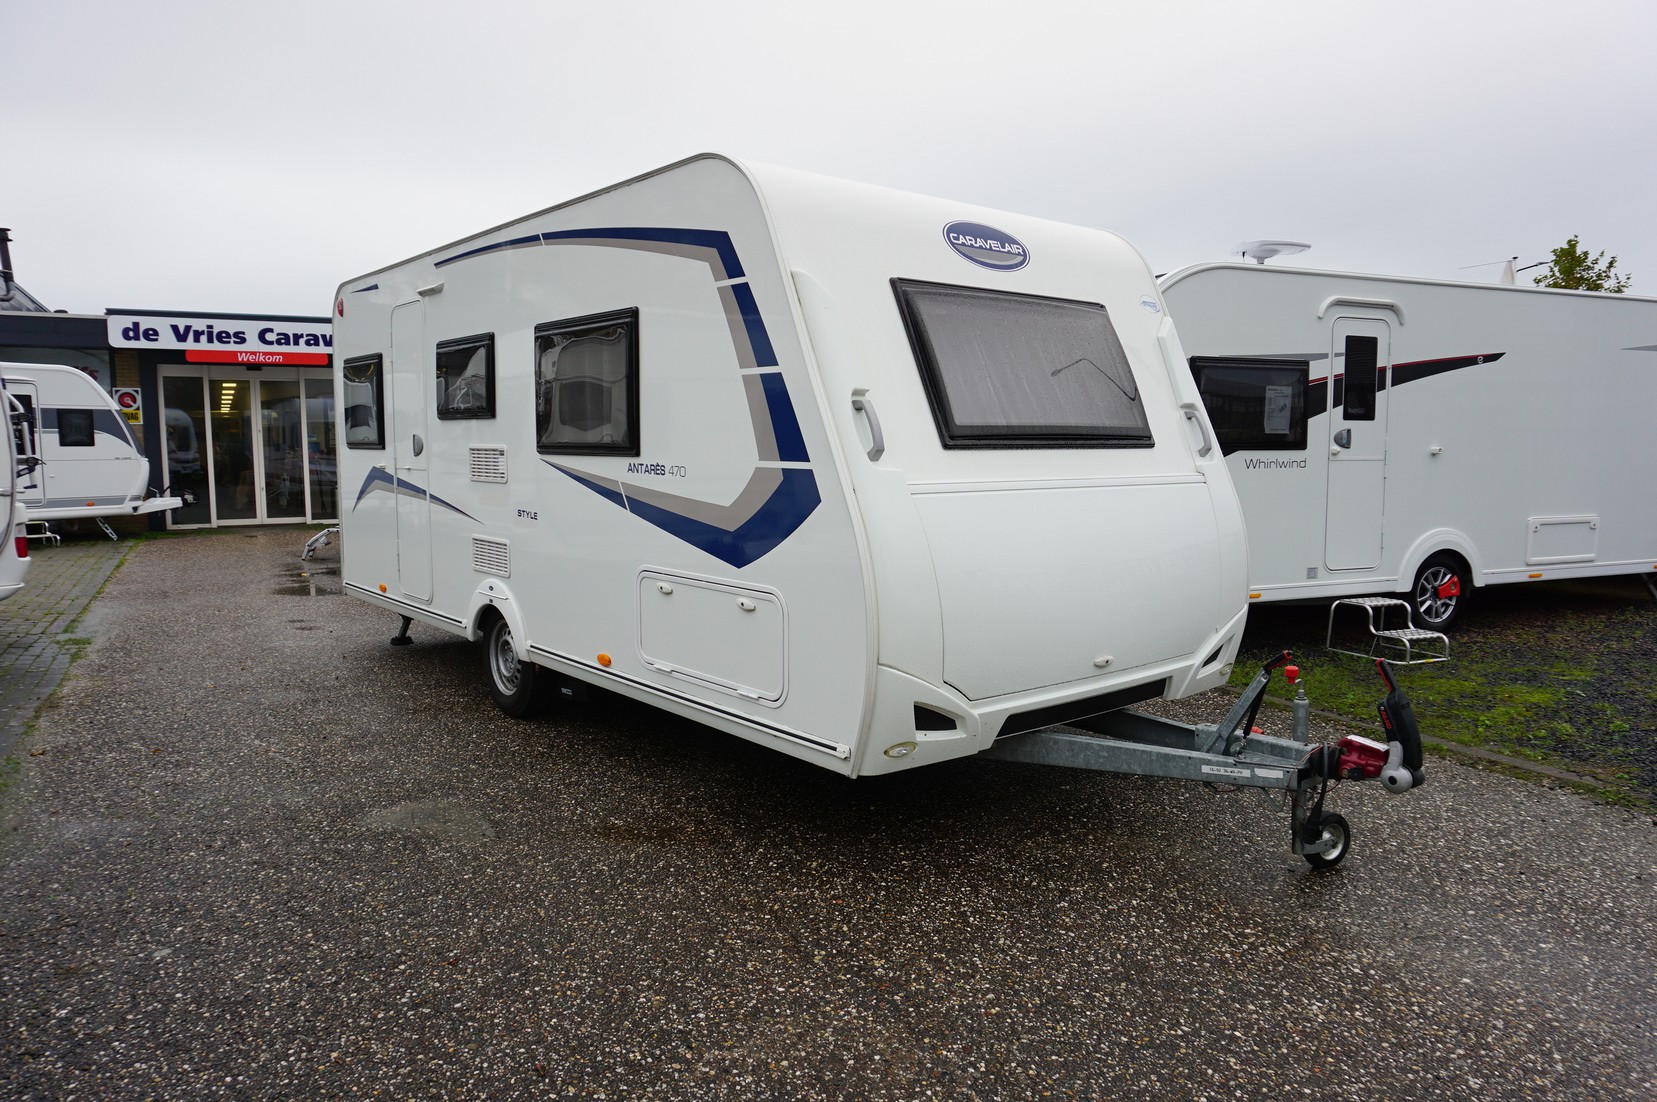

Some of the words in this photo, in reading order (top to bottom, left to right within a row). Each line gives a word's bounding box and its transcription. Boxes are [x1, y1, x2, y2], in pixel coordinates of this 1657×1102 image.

[949, 232, 1024, 255] CARAVELAIR
[121, 321, 160, 342] de
[170, 324, 247, 345] Vries
[237, 352, 283, 363] Welkom
[627, 462, 666, 476] ANTARÈS
[668, 465, 687, 478] 470
[1244, 458, 1307, 470] Whirlwind
[517, 509, 538, 520] STYLE
